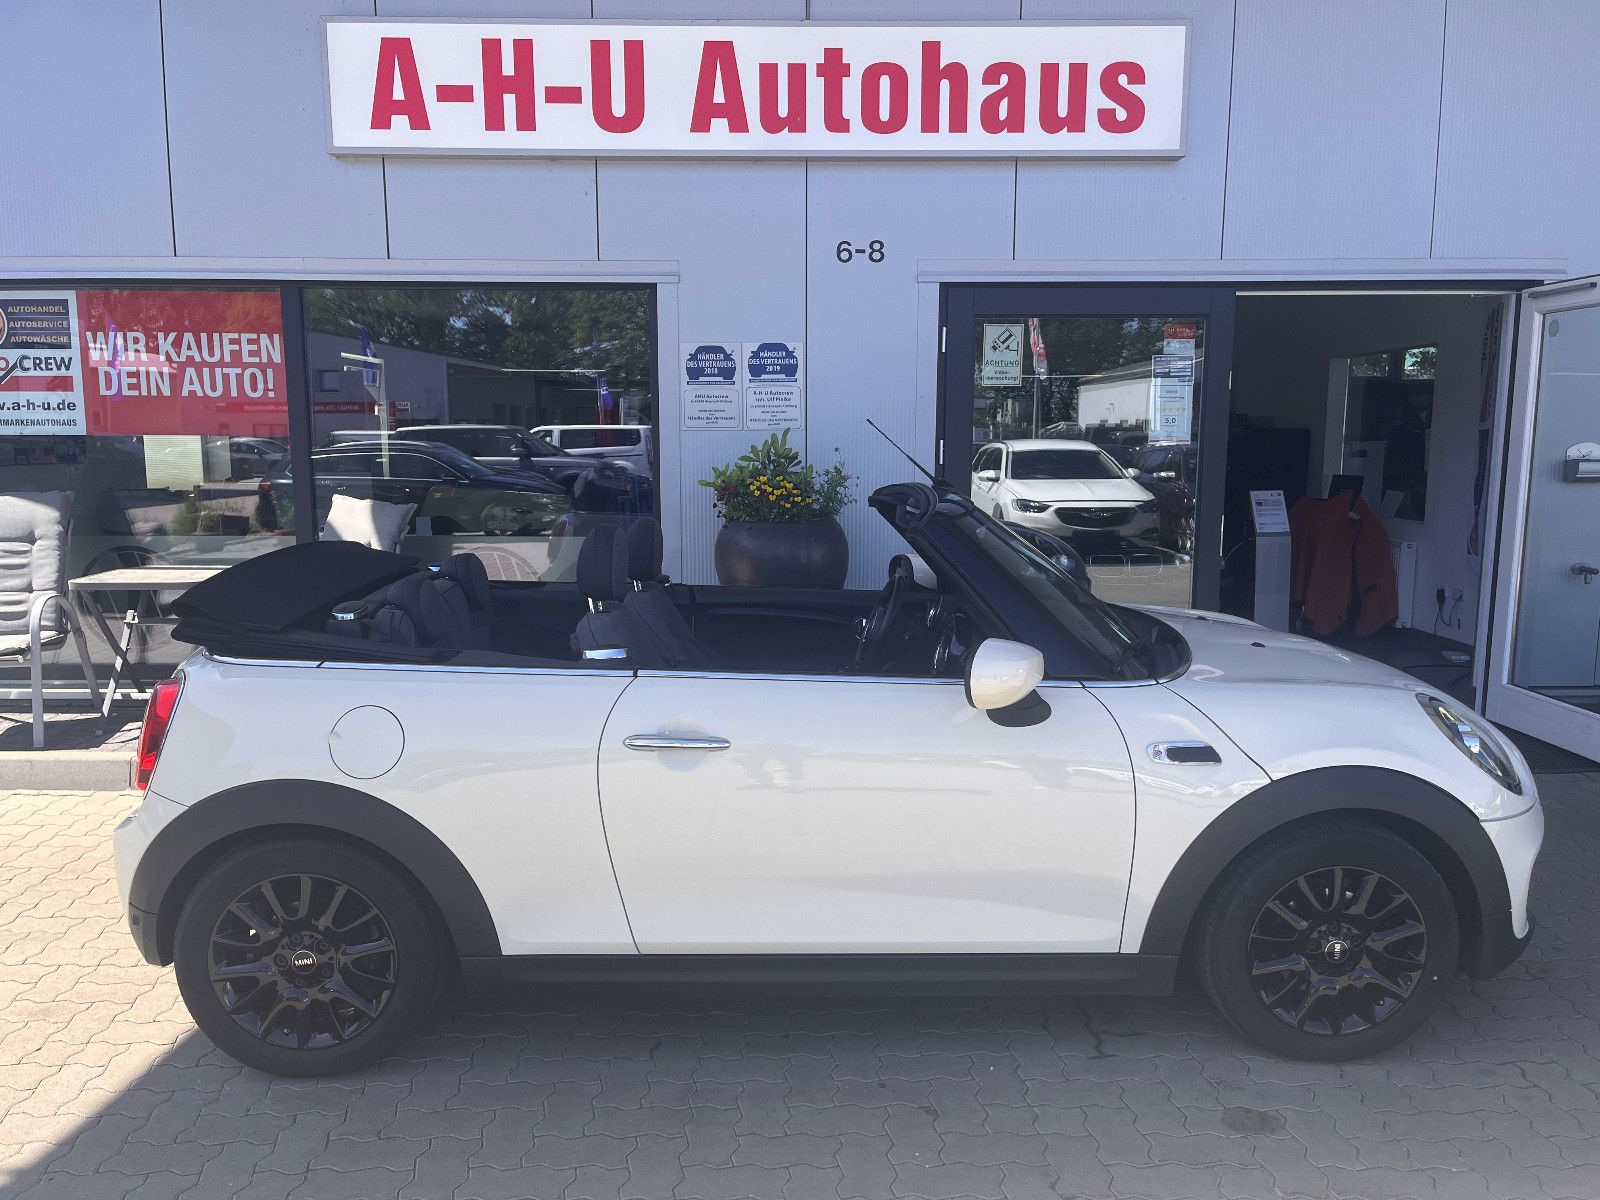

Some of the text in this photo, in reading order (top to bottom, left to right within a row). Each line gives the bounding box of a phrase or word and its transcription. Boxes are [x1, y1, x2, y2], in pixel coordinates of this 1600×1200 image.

[370, 37, 1146, 134] A-H-U Autohaus
[836, 240, 884, 263] 6-8
[7, 305, 65, 313] AUTOHANDEL
[9, 320, 69, 328] AUTOSERVICE
[10, 334, 70, 343] AUTOWÄSCHE
[86, 331, 281, 363] WIR KAUFEN
[698, 352, 724, 360] HÄNDLER
[98, 366, 275, 398] DEIN AUTO!
